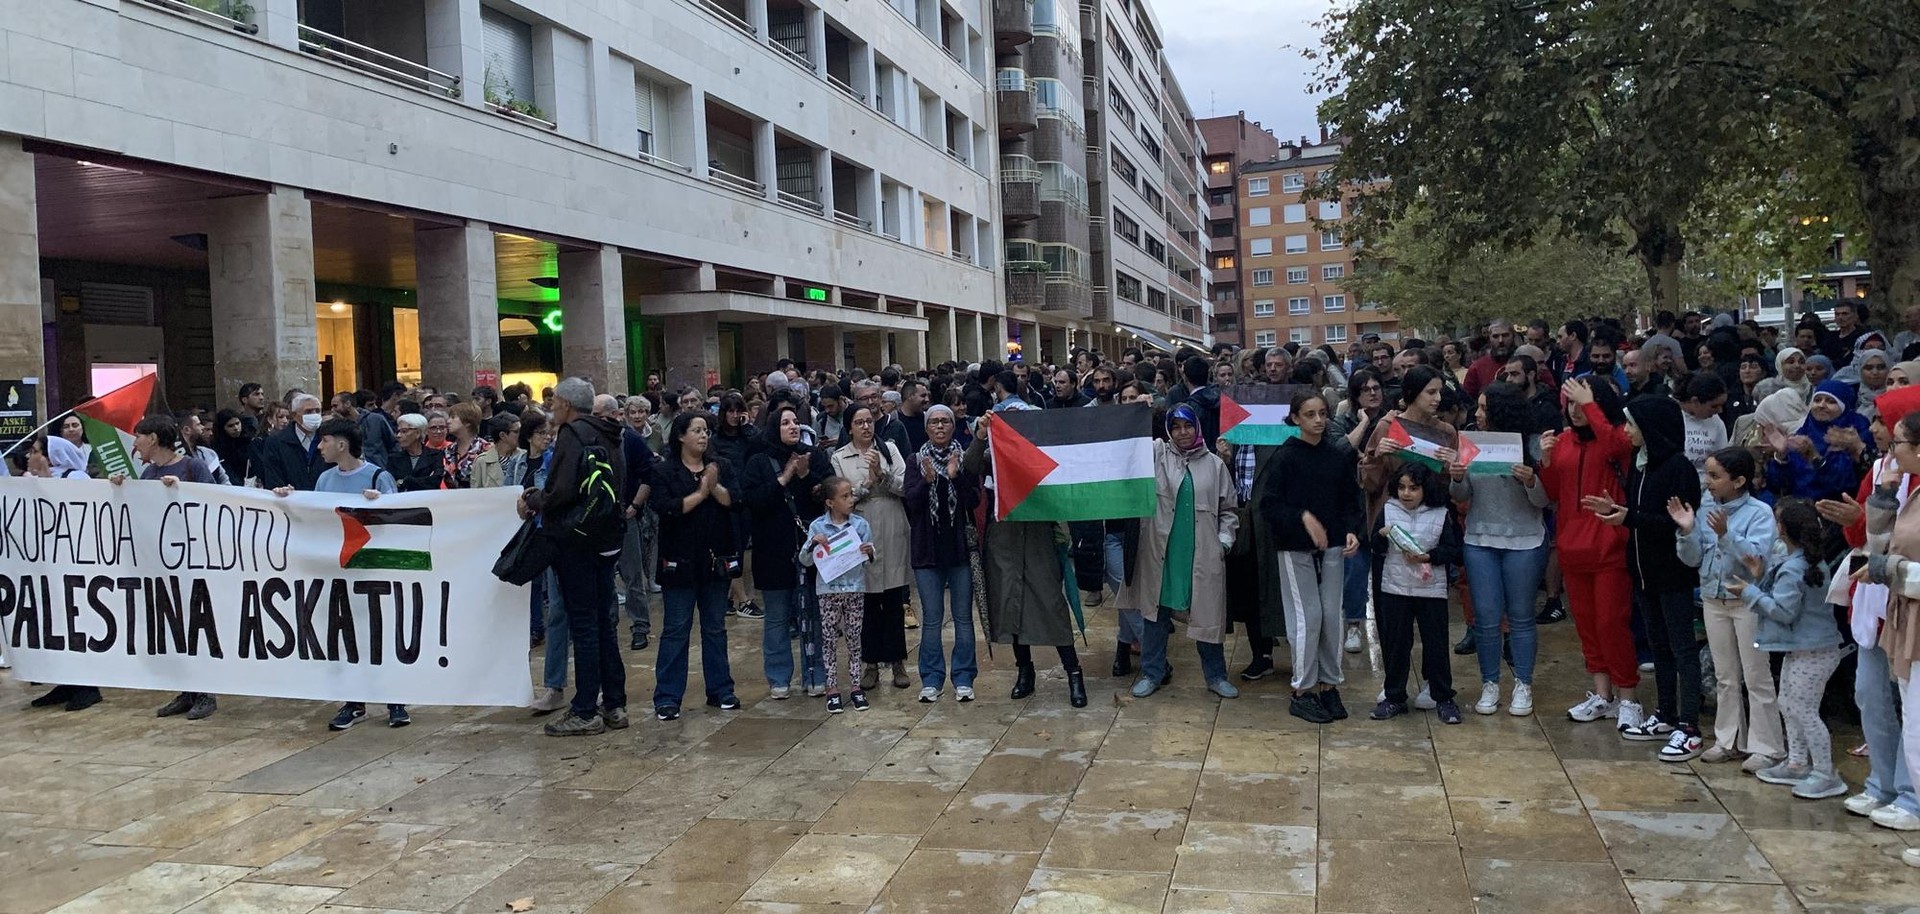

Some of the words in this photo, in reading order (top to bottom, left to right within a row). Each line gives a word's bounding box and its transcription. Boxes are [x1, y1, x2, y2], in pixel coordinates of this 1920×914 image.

[3, 417, 26, 425] ASKE
[0, 495, 137, 567] KUPAZIOA
[159, 502, 290, 572] GELDITU
